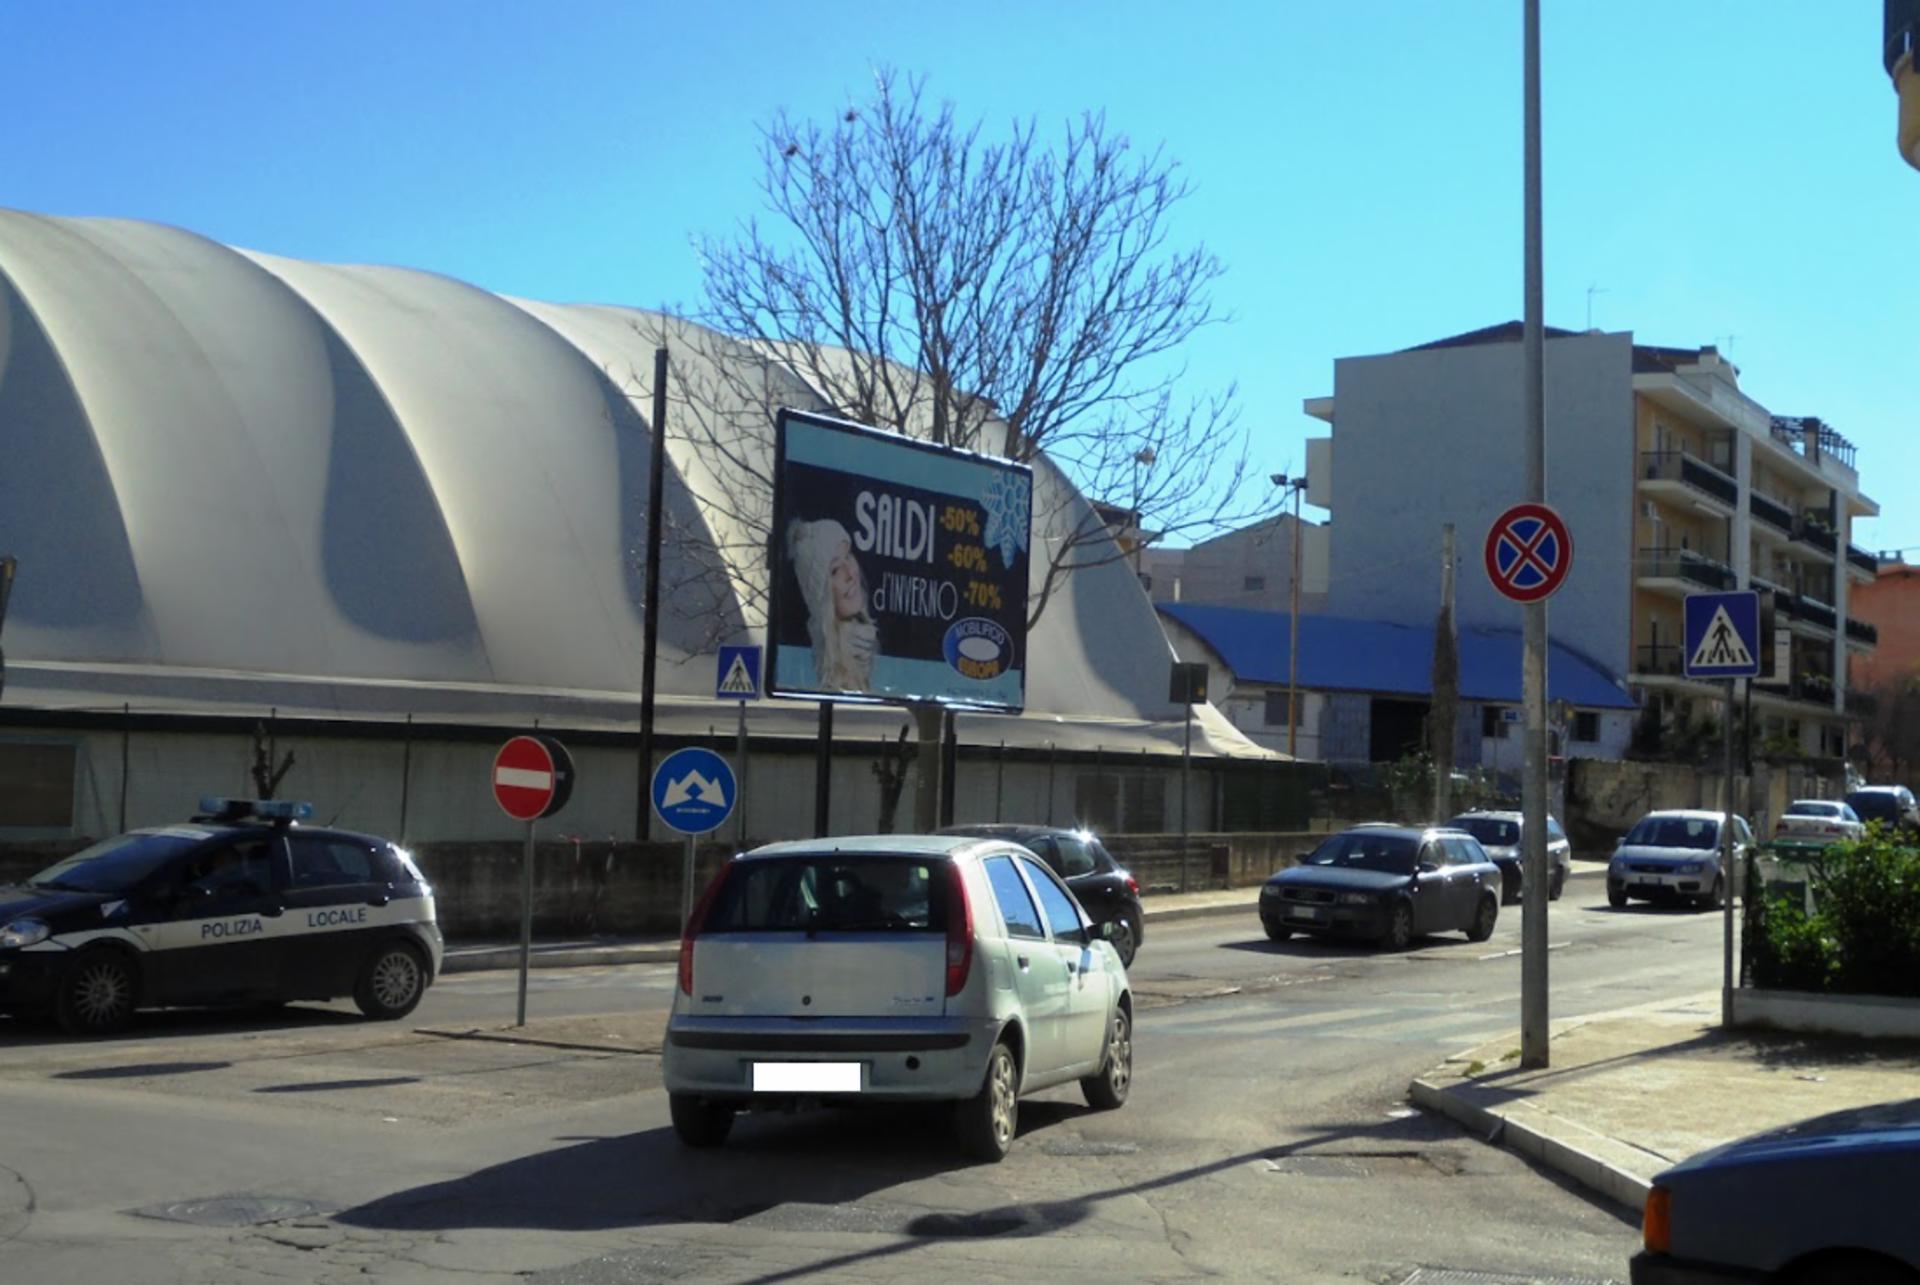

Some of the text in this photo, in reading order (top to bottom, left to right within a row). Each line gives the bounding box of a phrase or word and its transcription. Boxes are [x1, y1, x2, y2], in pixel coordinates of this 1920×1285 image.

[854, 490, 935, 563] SALDI
[940, 506, 980, 536] -50%
[963, 581, 1002, 609] -70%
[201, 907, 367, 939] POLIZIA LOCALE
